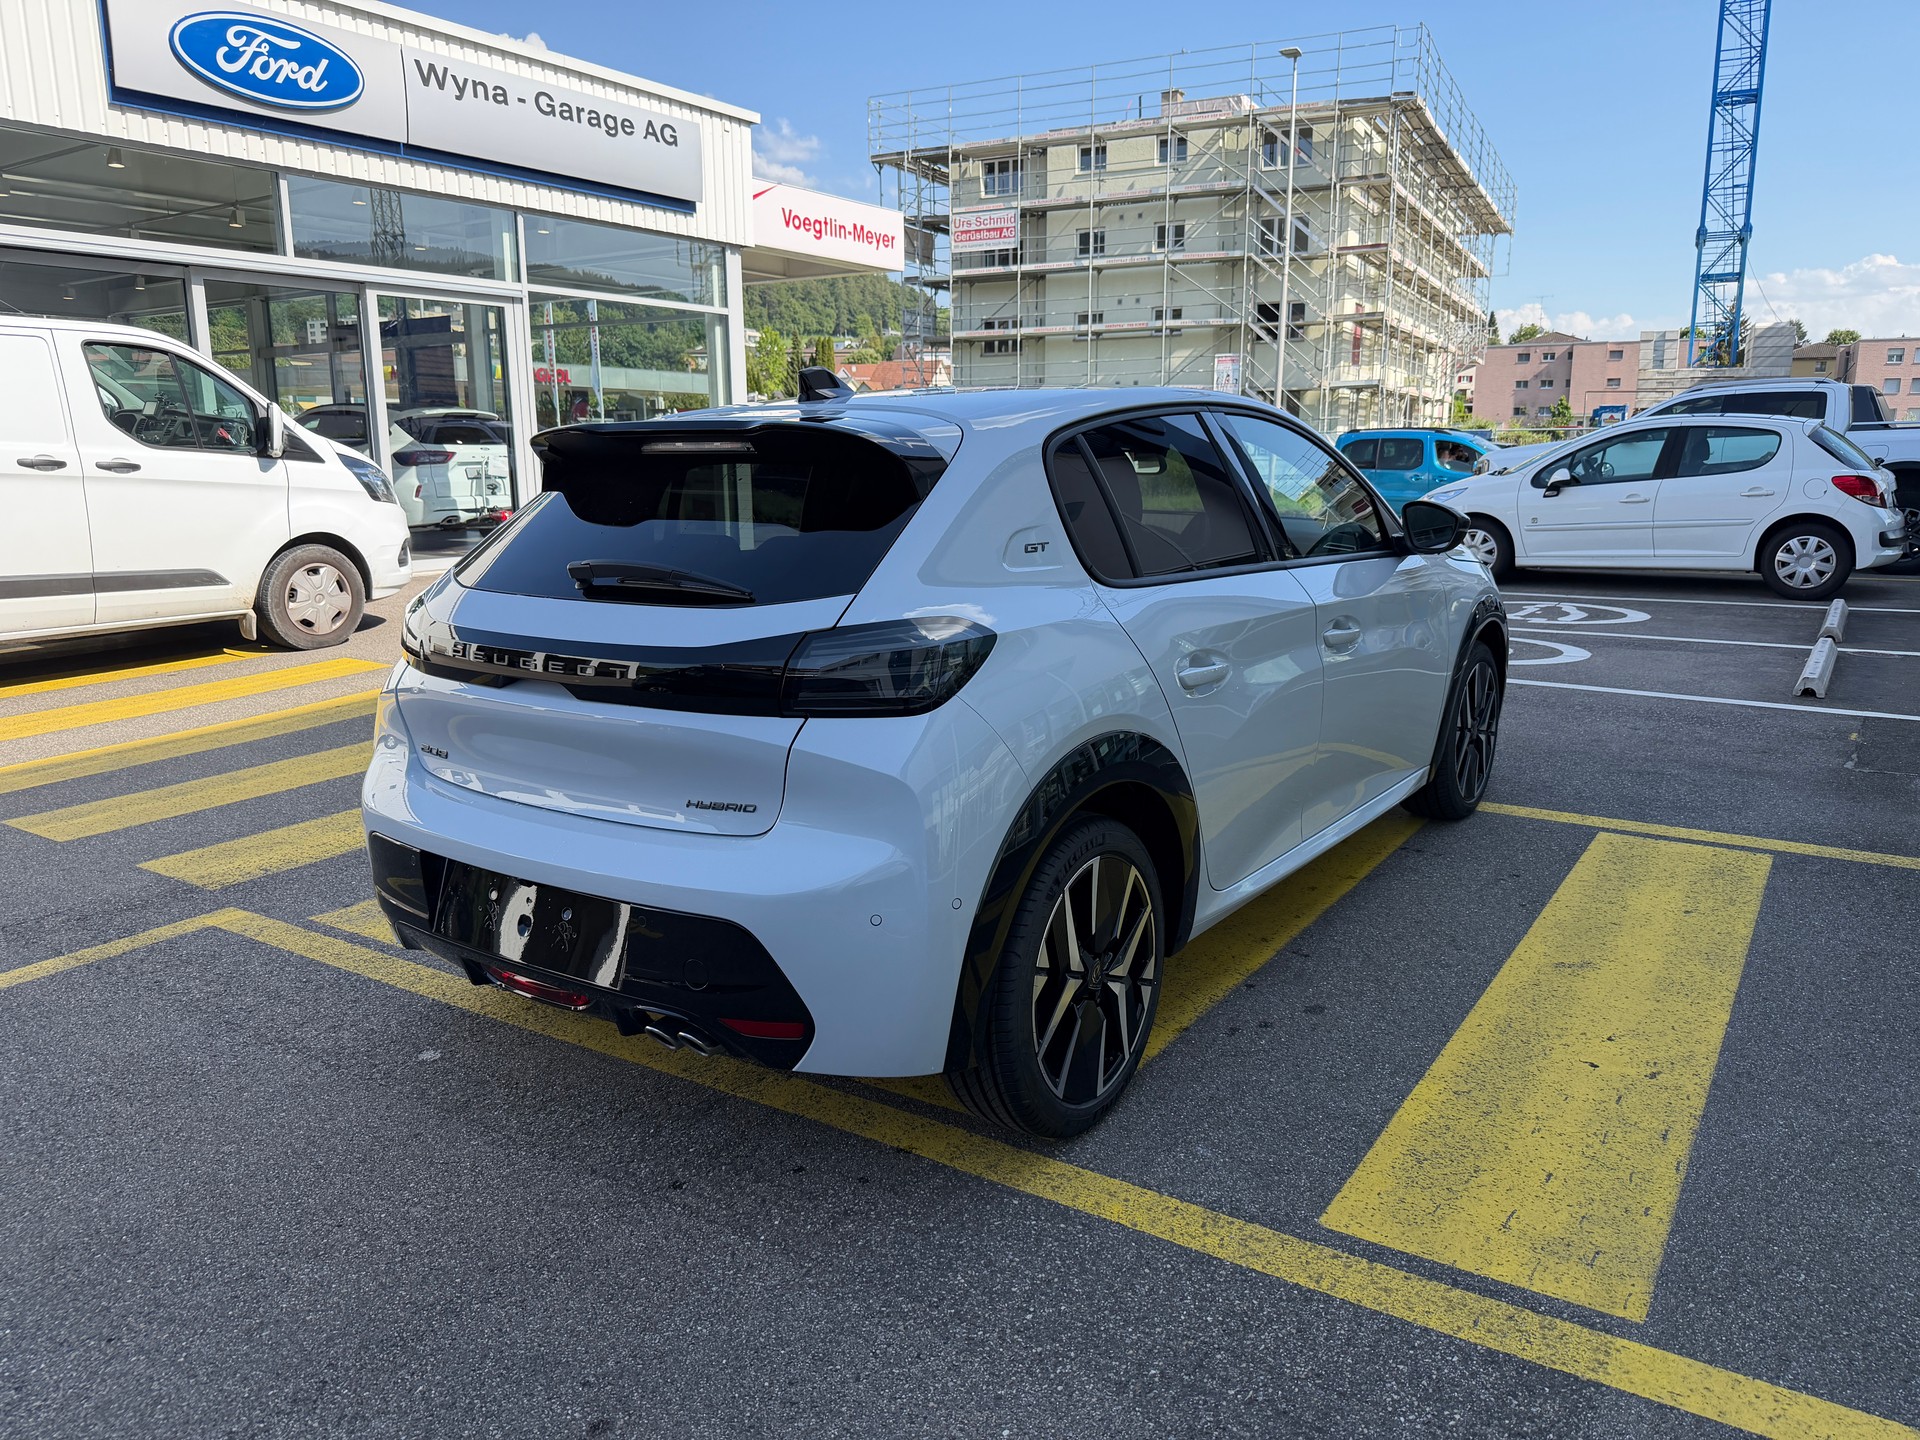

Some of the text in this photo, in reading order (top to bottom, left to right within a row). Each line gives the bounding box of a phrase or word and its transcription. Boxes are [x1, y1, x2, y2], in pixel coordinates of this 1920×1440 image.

[216, 25, 329, 92] Ford
[414, 58, 509, 106] Wyna
[534, 91, 635, 138] Garage
[643, 119, 679, 147] AG
[781, 207, 896, 251] Voegtlin-Meyer
[953, 212, 1016, 229] Urs Schmid
[1001, 227, 1015, 238] AG
[1024, 541, 1050, 554] GT
[452, 645, 628, 679] PEUGEOT
[685, 799, 757, 813] HYBRID
